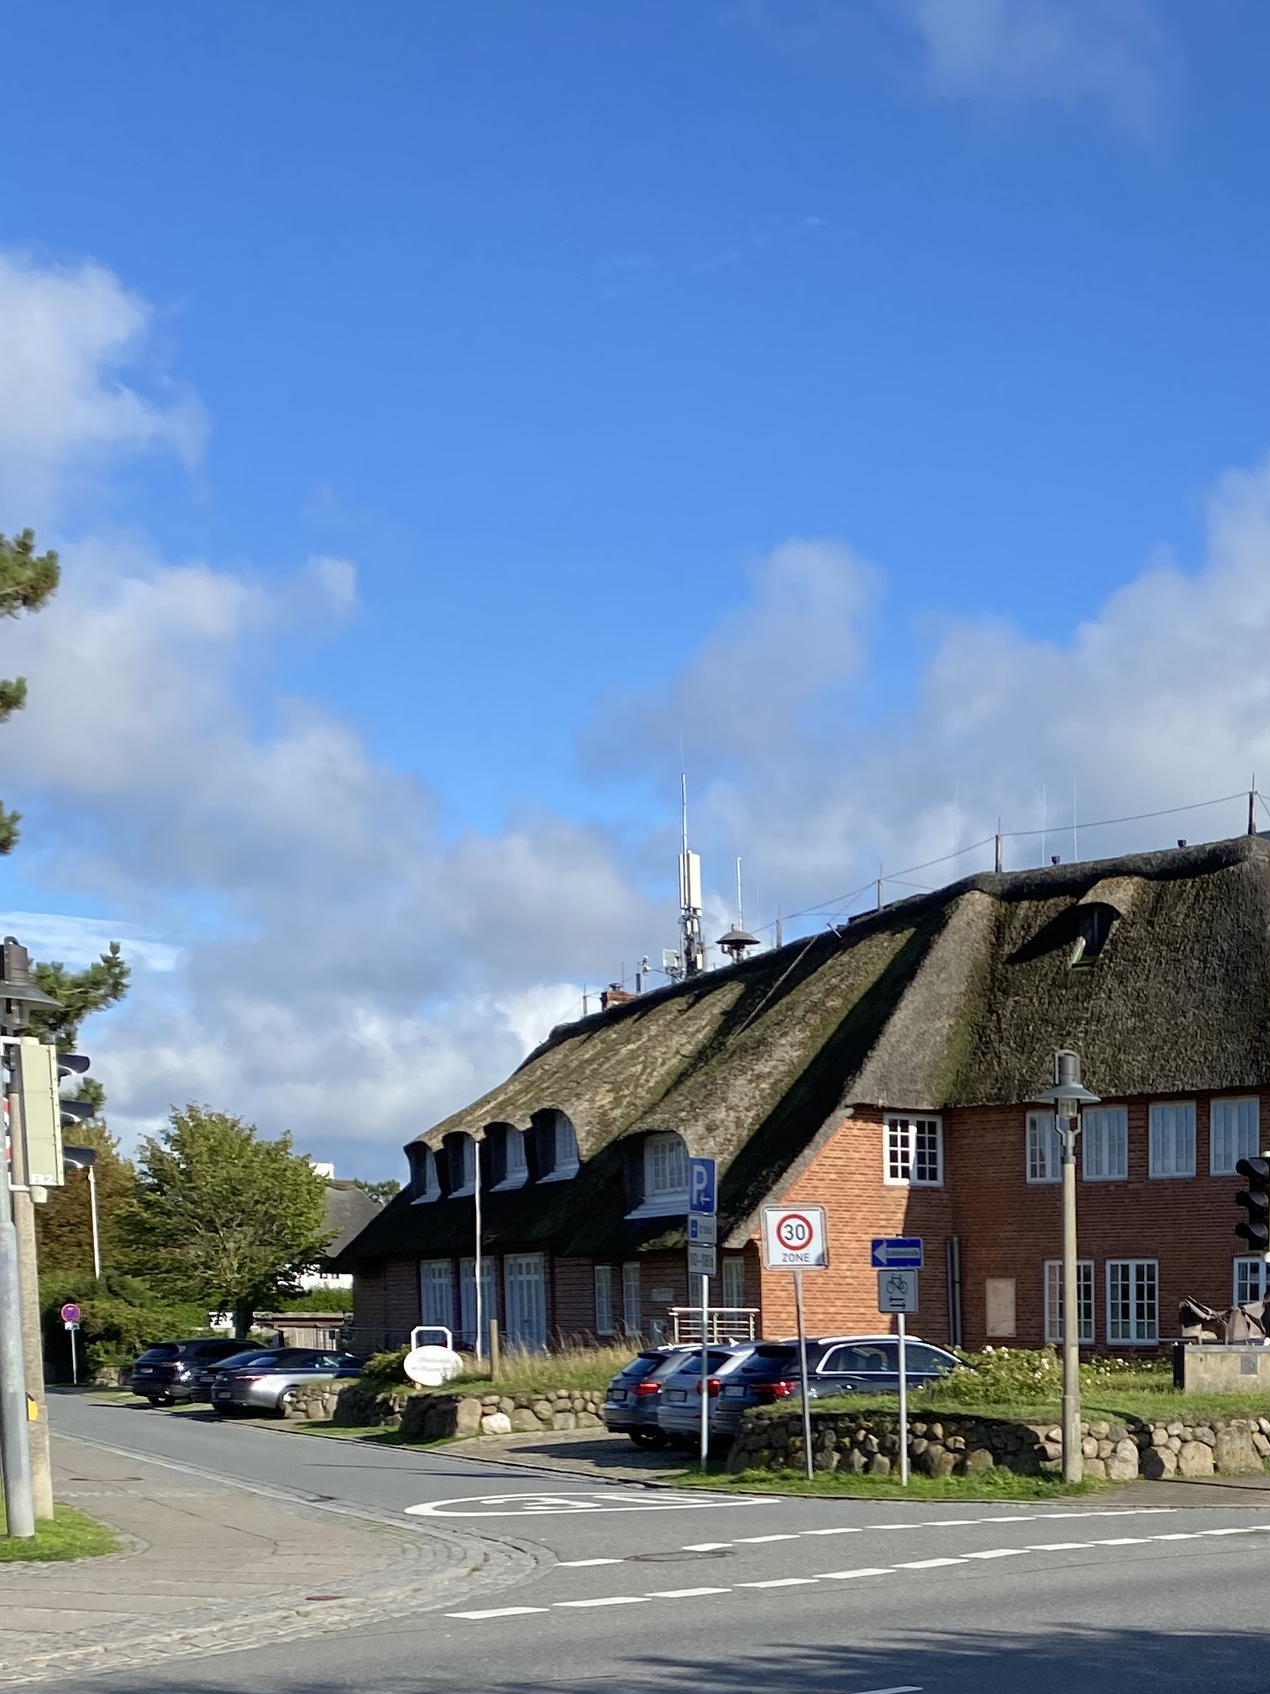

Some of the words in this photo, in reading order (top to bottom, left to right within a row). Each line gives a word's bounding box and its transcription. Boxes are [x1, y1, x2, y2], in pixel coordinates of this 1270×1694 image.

[692, 1165, 707, 1205] P
[784, 1223, 806, 1241] 30
[782, 1253, 811, 1263] ZONE
